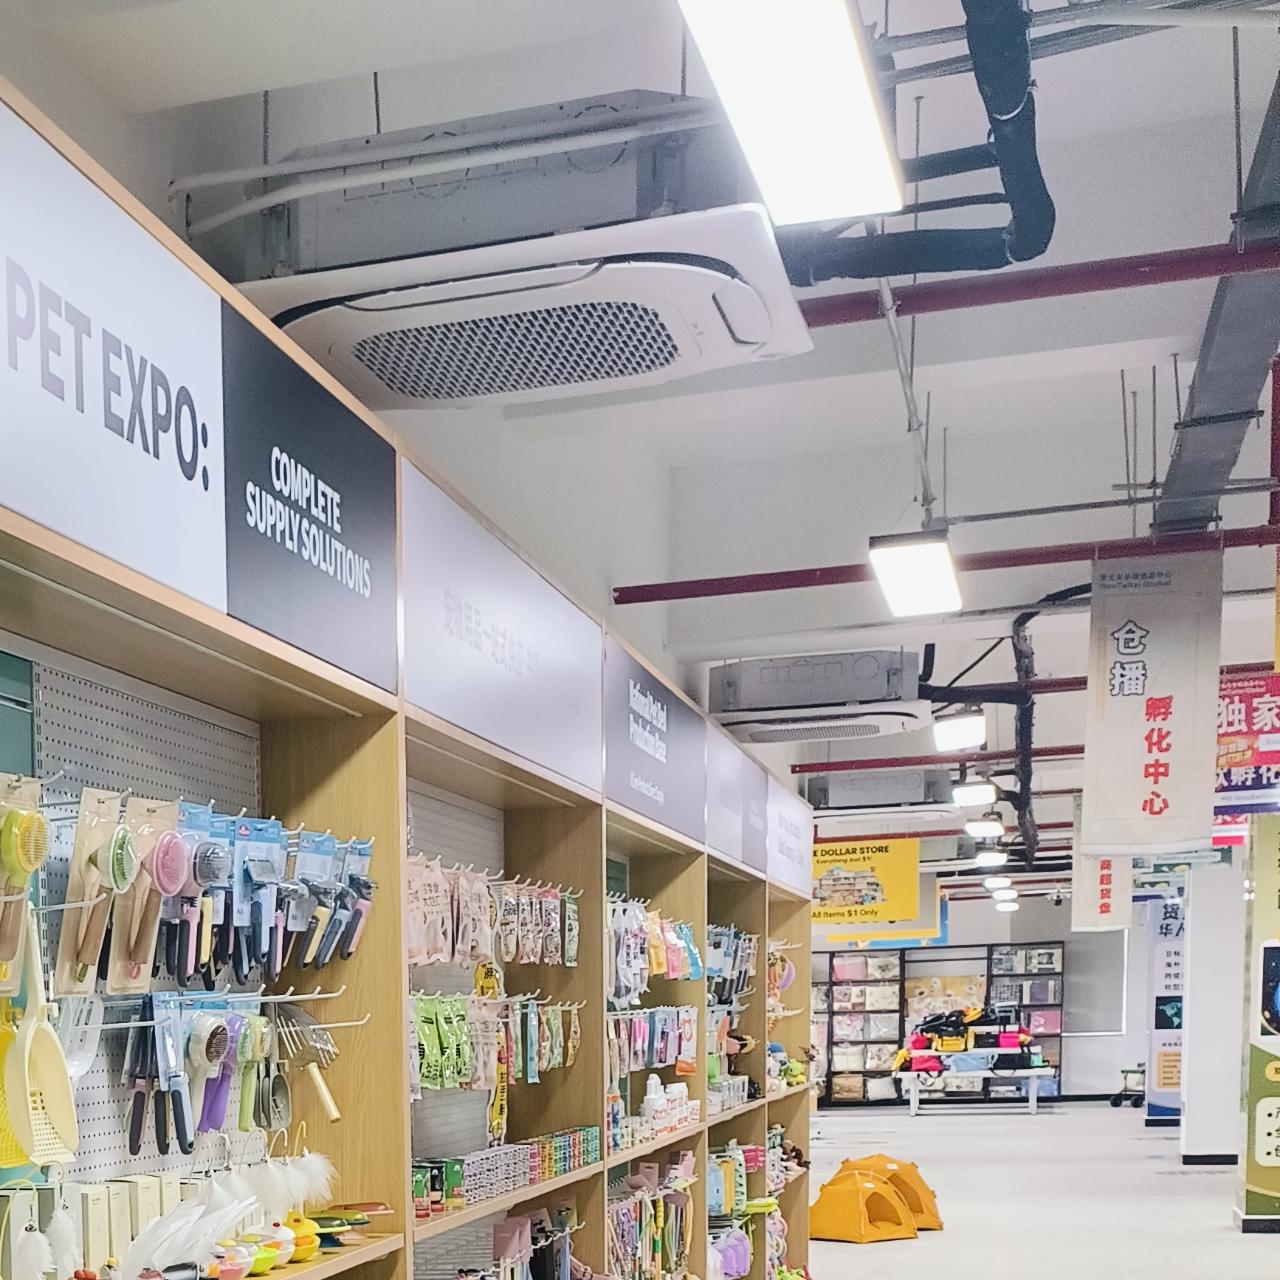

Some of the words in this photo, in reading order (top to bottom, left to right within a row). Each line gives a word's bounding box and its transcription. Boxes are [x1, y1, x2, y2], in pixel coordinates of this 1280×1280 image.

[5, 255, 91, 414] PET
[101, 328, 209, 492] EXPO:
[270, 446, 341, 534] COMPLETE
[245, 481, 300, 554] SUPPLY
[300, 518, 372, 598] SOLUTIONS
[1110, 619, 1150, 698] 仓播
[1142, 695, 1174, 816] 孵化中心
[820, 847, 857, 857] DOLLAR
[859, 845, 889, 854] STORE
[823, 910, 845, 918] Items
[859, 909, 879, 917] Only
